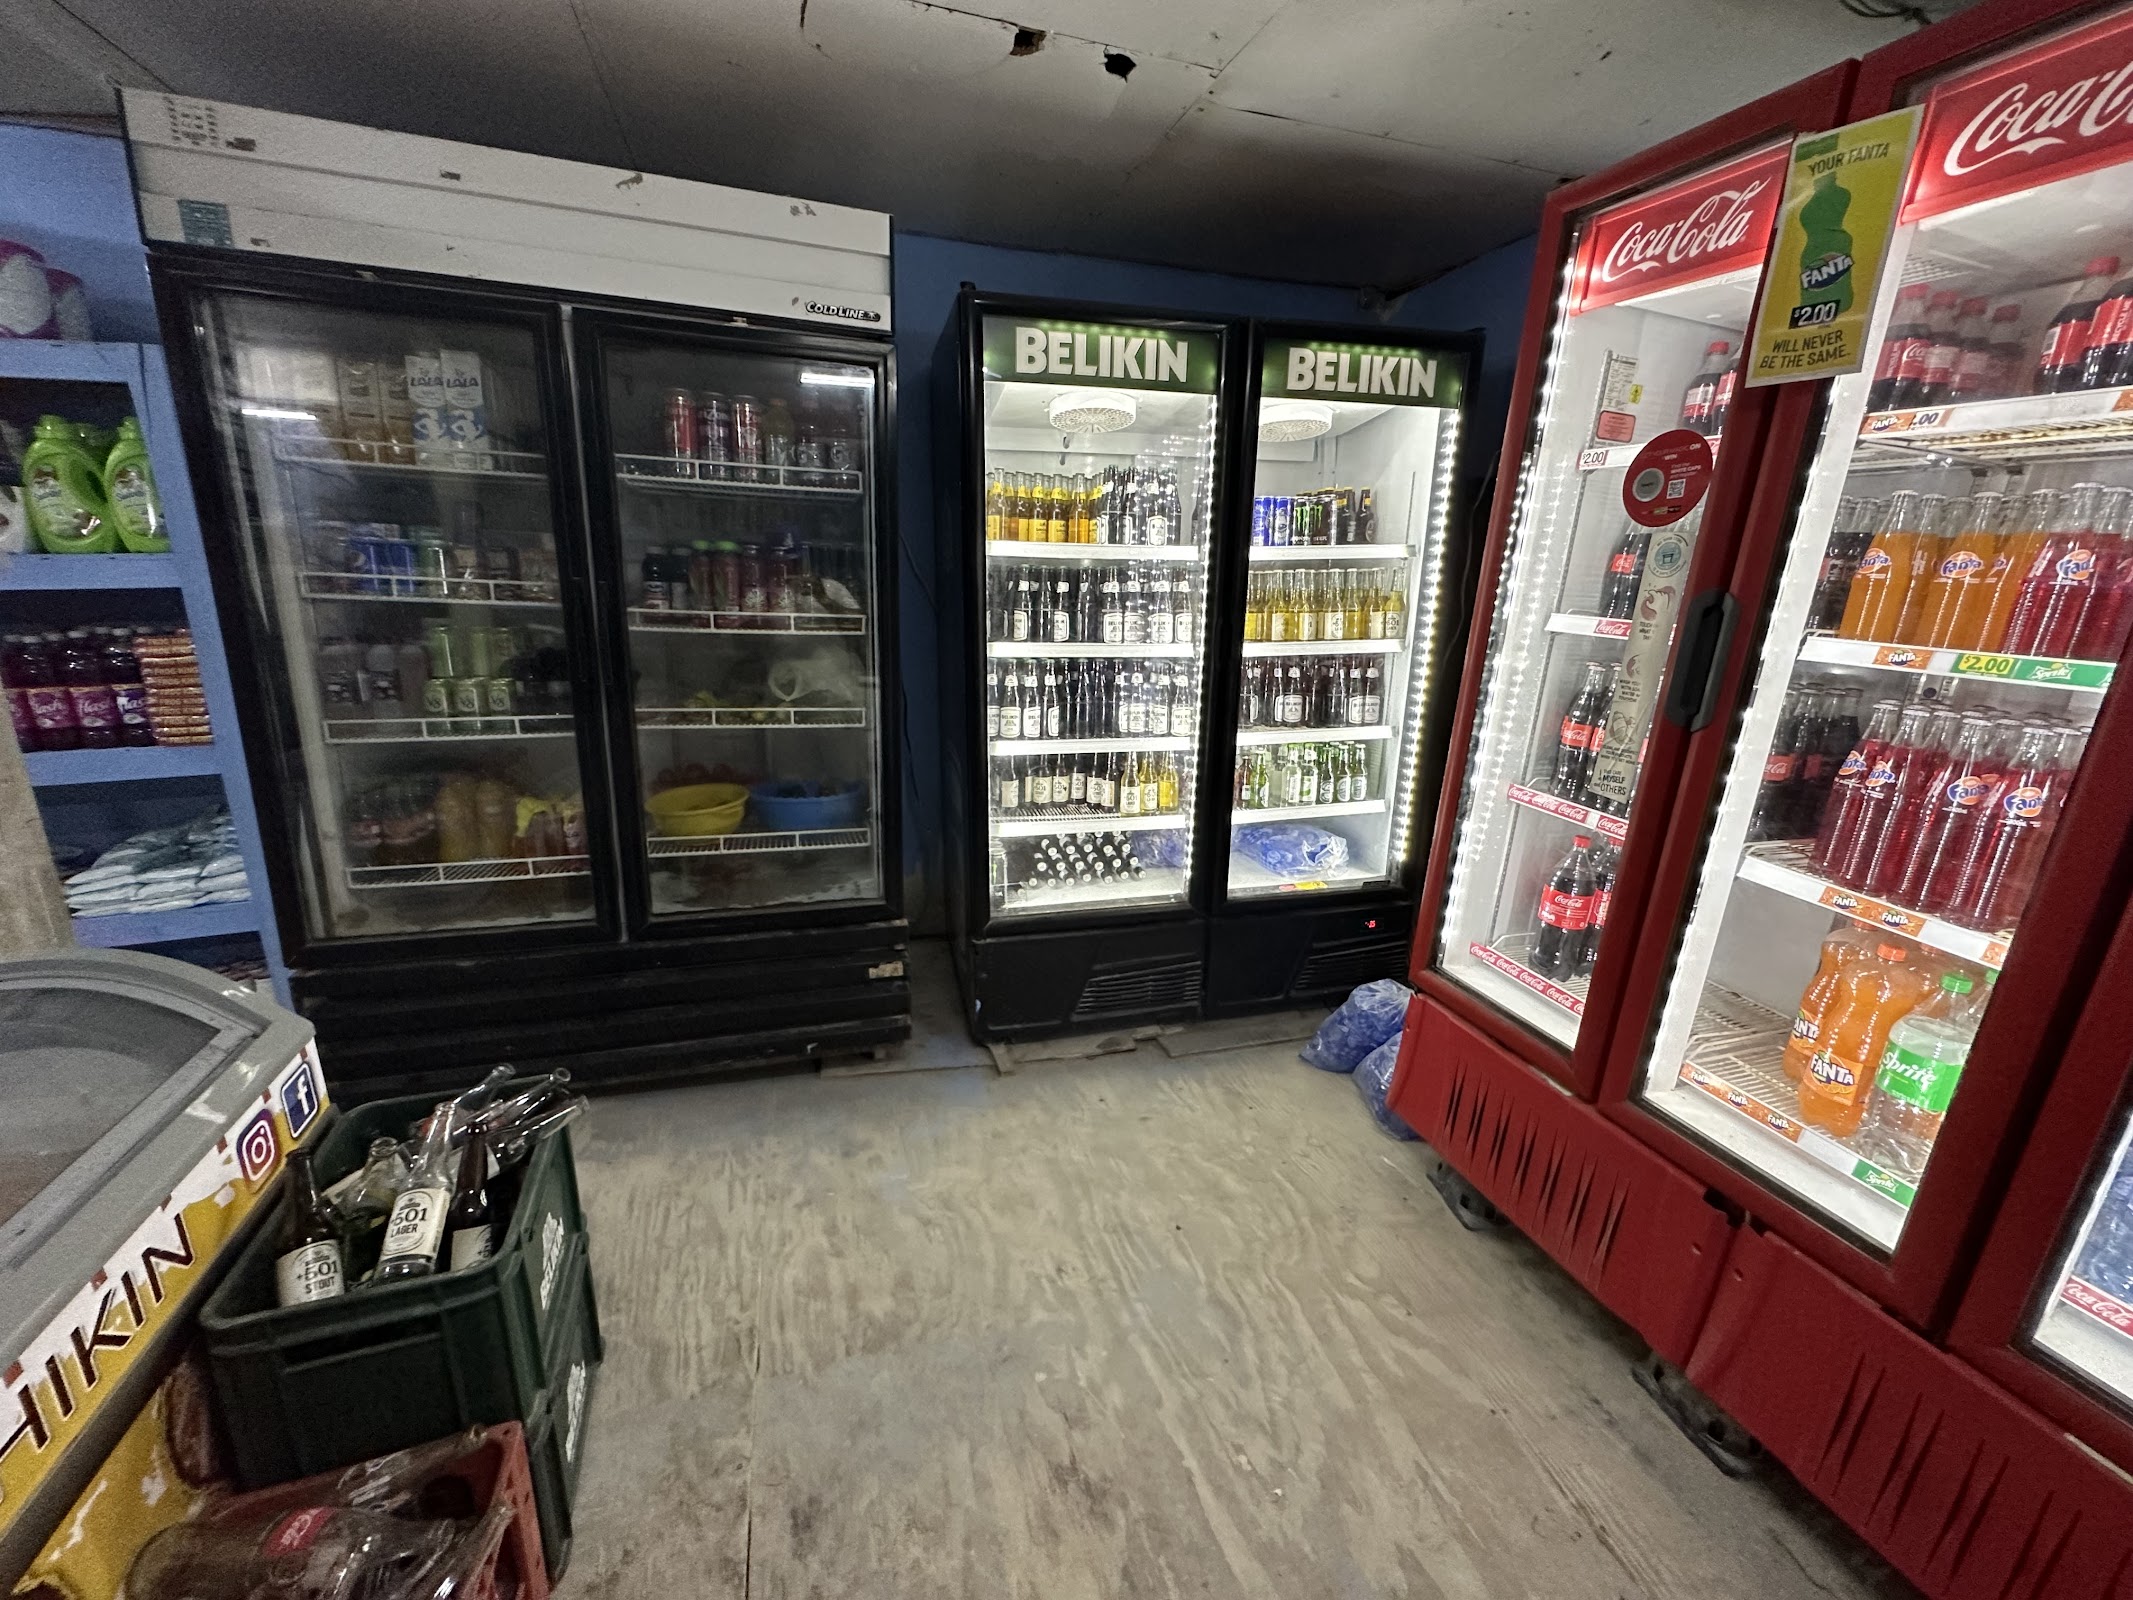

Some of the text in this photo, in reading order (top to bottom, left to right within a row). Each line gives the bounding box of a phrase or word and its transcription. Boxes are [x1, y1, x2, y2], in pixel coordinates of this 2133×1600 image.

[1943, 60, 2133, 176] Coca-C
[1808, 143, 1889, 177] YOUR FANTA
[1602, 176, 1772, 282] Coca-Cola
[1800, 254, 1854, 290] FANTA
[1793, 302, 1836, 327] $2.00
[1772, 330, 1844, 353] WILL NEVER
[1016, 326, 1188, 382] BELIKIN
[1760, 355, 1779, 369] BE
[1781, 351, 1804, 367] THE
[1287, 347, 1437, 398] BELIKIN
[1871, 416, 1898, 431] FANTA
[1583, 451, 1604, 464] $2.00
[1942, 556, 1983, 575] Fanta
[1888, 653, 1916, 665] FANTA
[1964, 655, 2010, 674] $2.00
[2031, 664, 2071, 680] Sprite
[1603, 774, 1626, 784] MYSELF
[1601, 783, 1627, 796] OTHERS
[1833, 896, 1909, 926] FANTA FANTA
[1811, 1055, 1854, 1085] FANTA
[1727, 1092, 1748, 1106] FANTA
[1767, 1114, 1789, 1129] FANTA
[390, 1223, 418, 1239] LAGER
[296, 1261, 340, 1281] +501
[305, 1278, 336, 1294] STOUT
